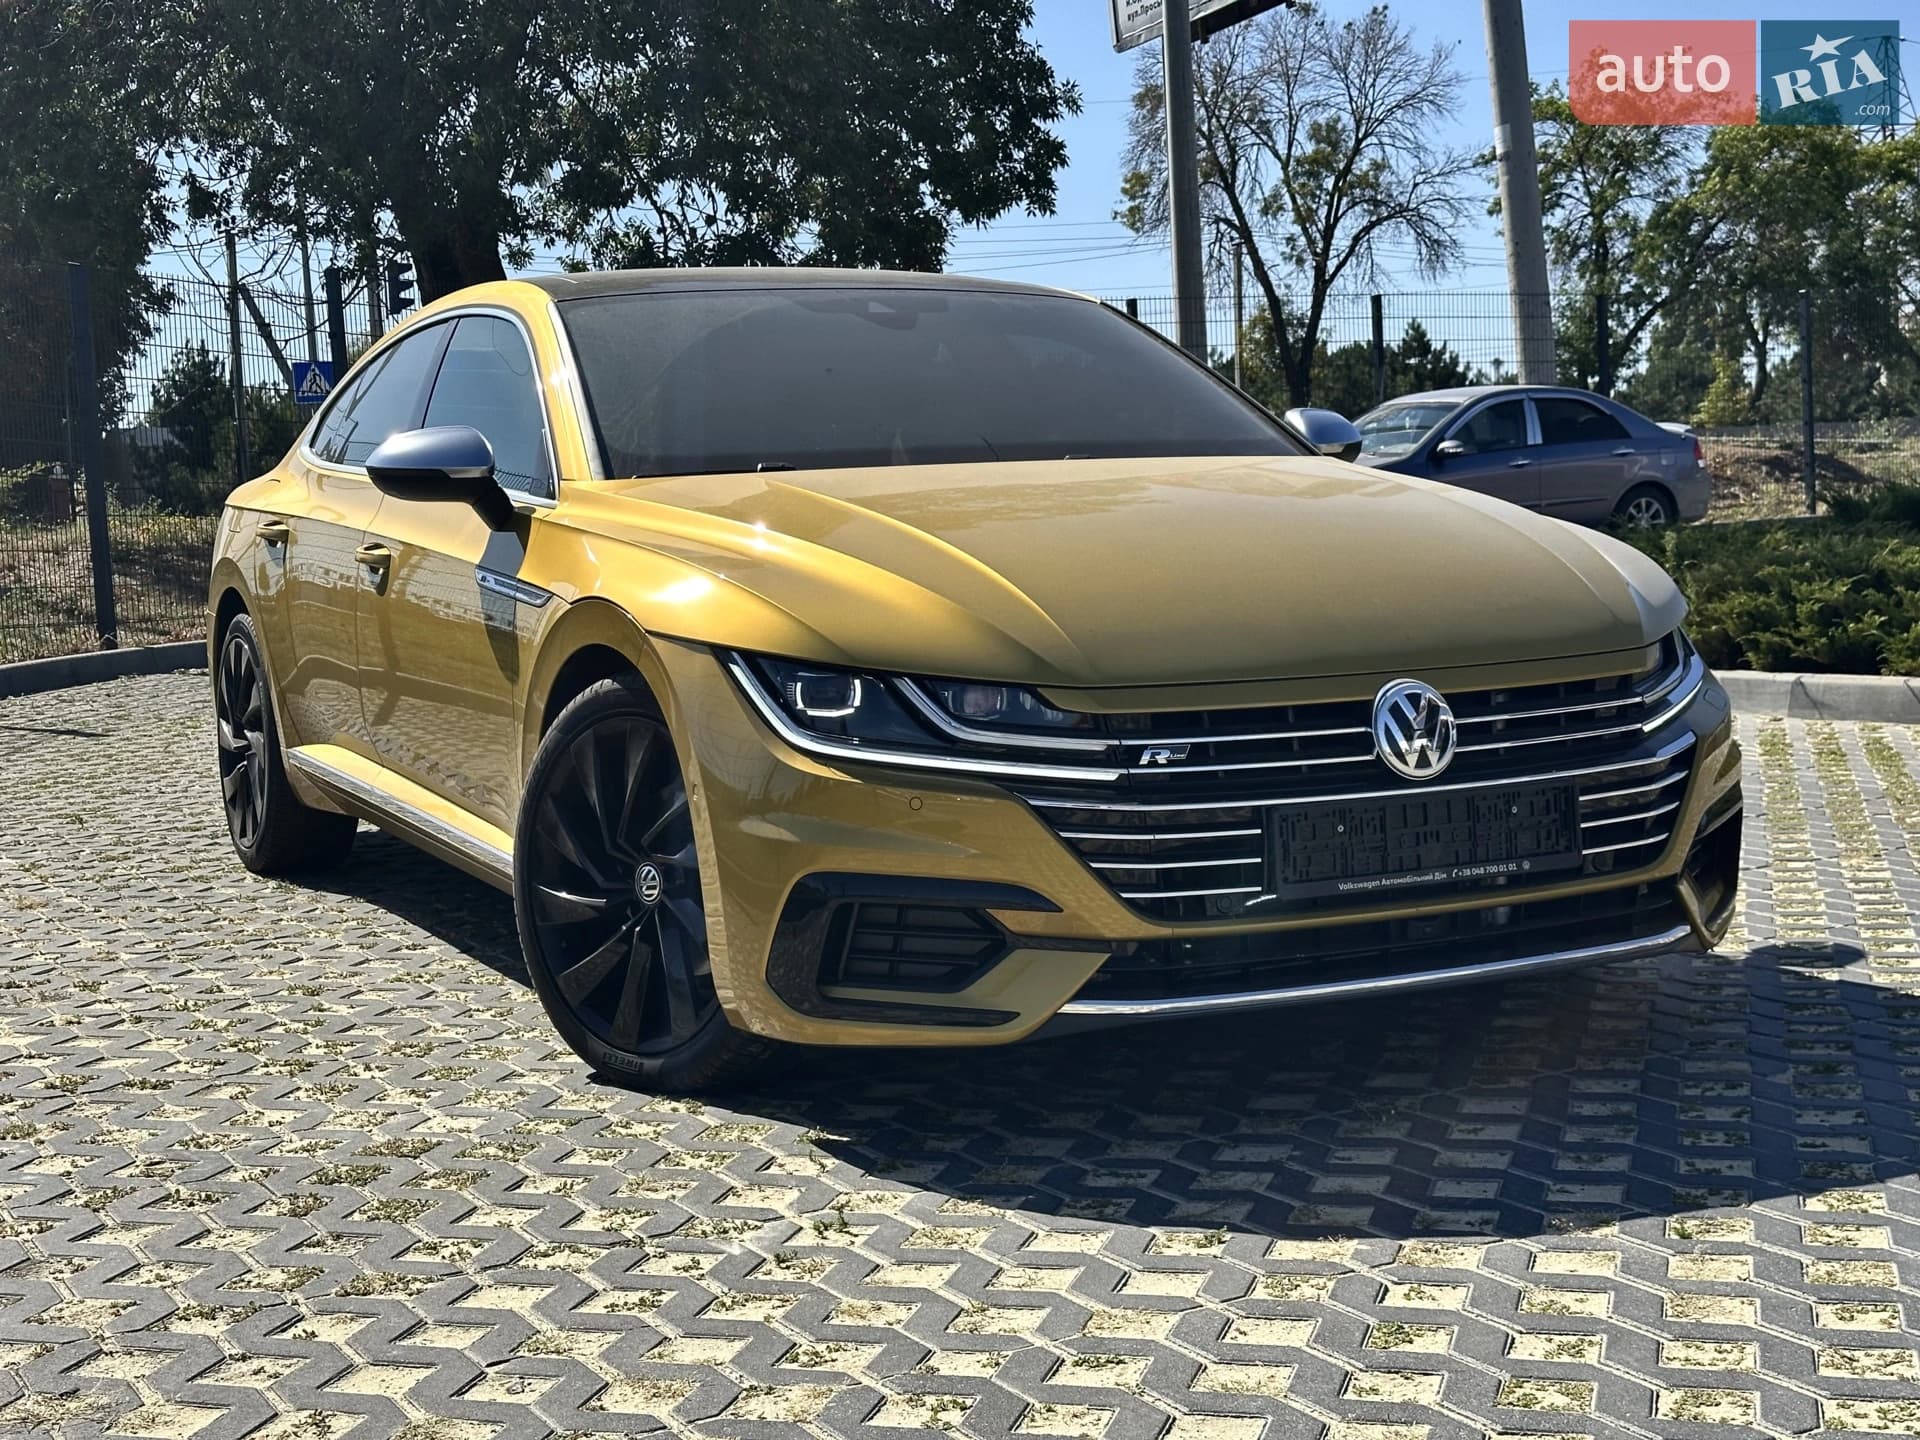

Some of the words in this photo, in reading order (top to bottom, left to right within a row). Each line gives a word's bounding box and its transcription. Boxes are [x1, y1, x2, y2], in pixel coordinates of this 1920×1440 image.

[1338, 880, 1380, 891] Volkswagen
[1382, 873, 1433, 886] Автомобільний
[1434, 872, 1447, 881] Дім
[1472, 867, 1484, 875] 048
[1484, 865, 1498, 873] 700
[1498, 864, 1507, 872] 01
[1508, 863, 1517, 871] 01
